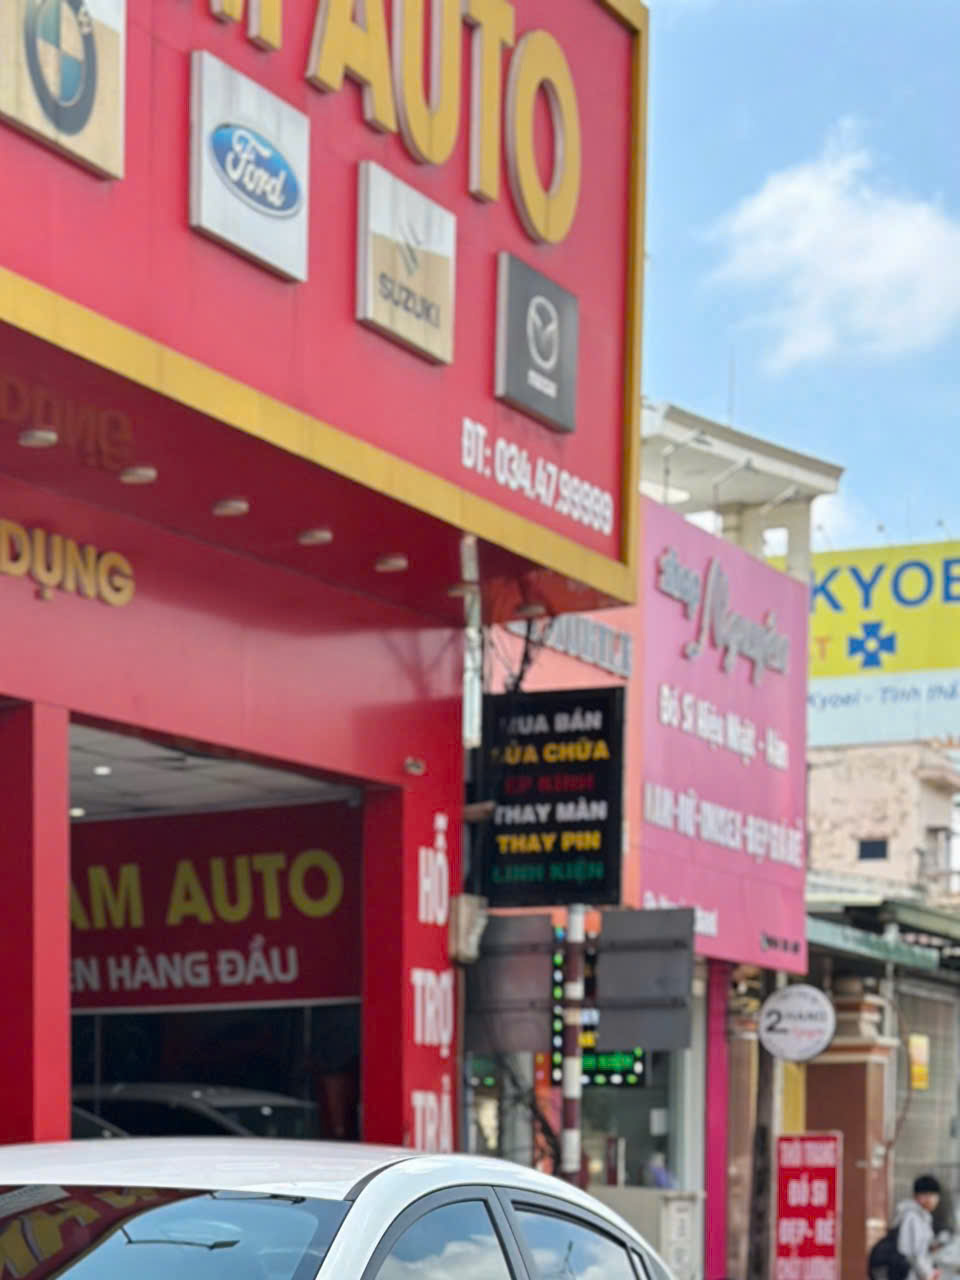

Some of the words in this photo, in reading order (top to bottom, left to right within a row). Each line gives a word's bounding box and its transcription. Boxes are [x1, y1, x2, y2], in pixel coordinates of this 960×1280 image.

[306, 0, 581, 244] AUTO
[225, 129, 288, 207] Ford
[379, 271, 440, 329] SUZUKI
[496, 831, 557, 855] THAY
[560, 829, 604, 853] PIN
[165, 848, 344, 928] AUTO
[107, 944, 212, 992] HÀNG
